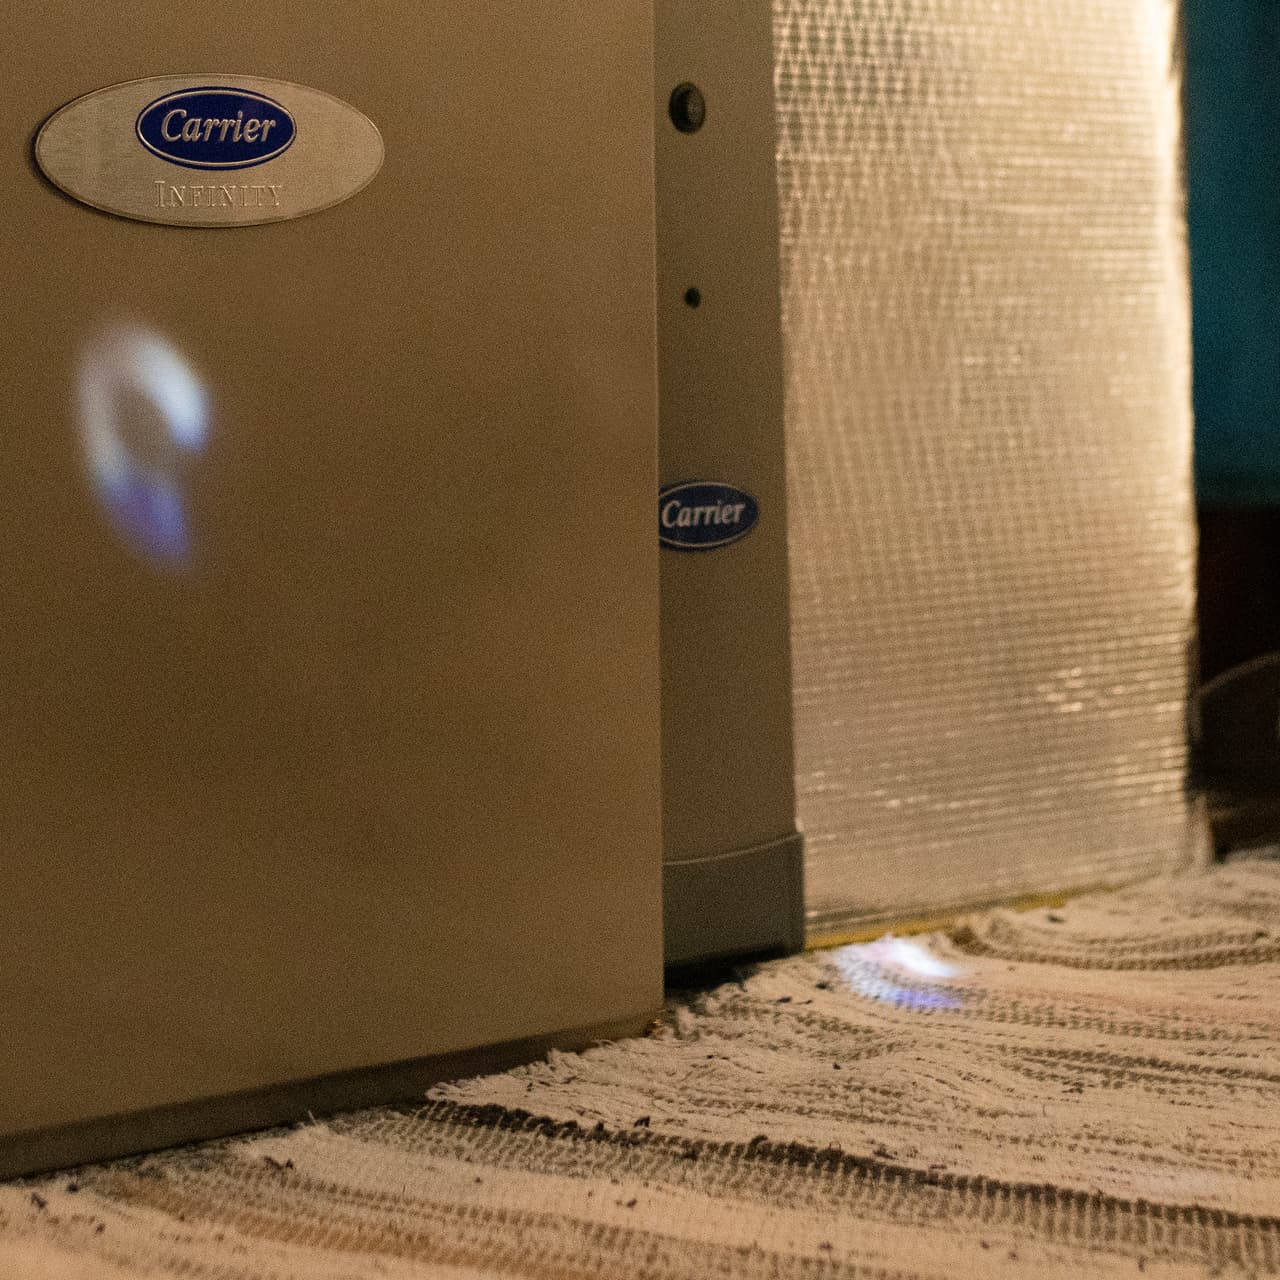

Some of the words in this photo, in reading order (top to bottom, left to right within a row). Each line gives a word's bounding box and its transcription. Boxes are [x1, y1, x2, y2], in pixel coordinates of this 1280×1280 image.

[161, 108, 276, 142] Carrier
[154, 180, 282, 207] INFINITY
[661, 500, 746, 528] Carrier
